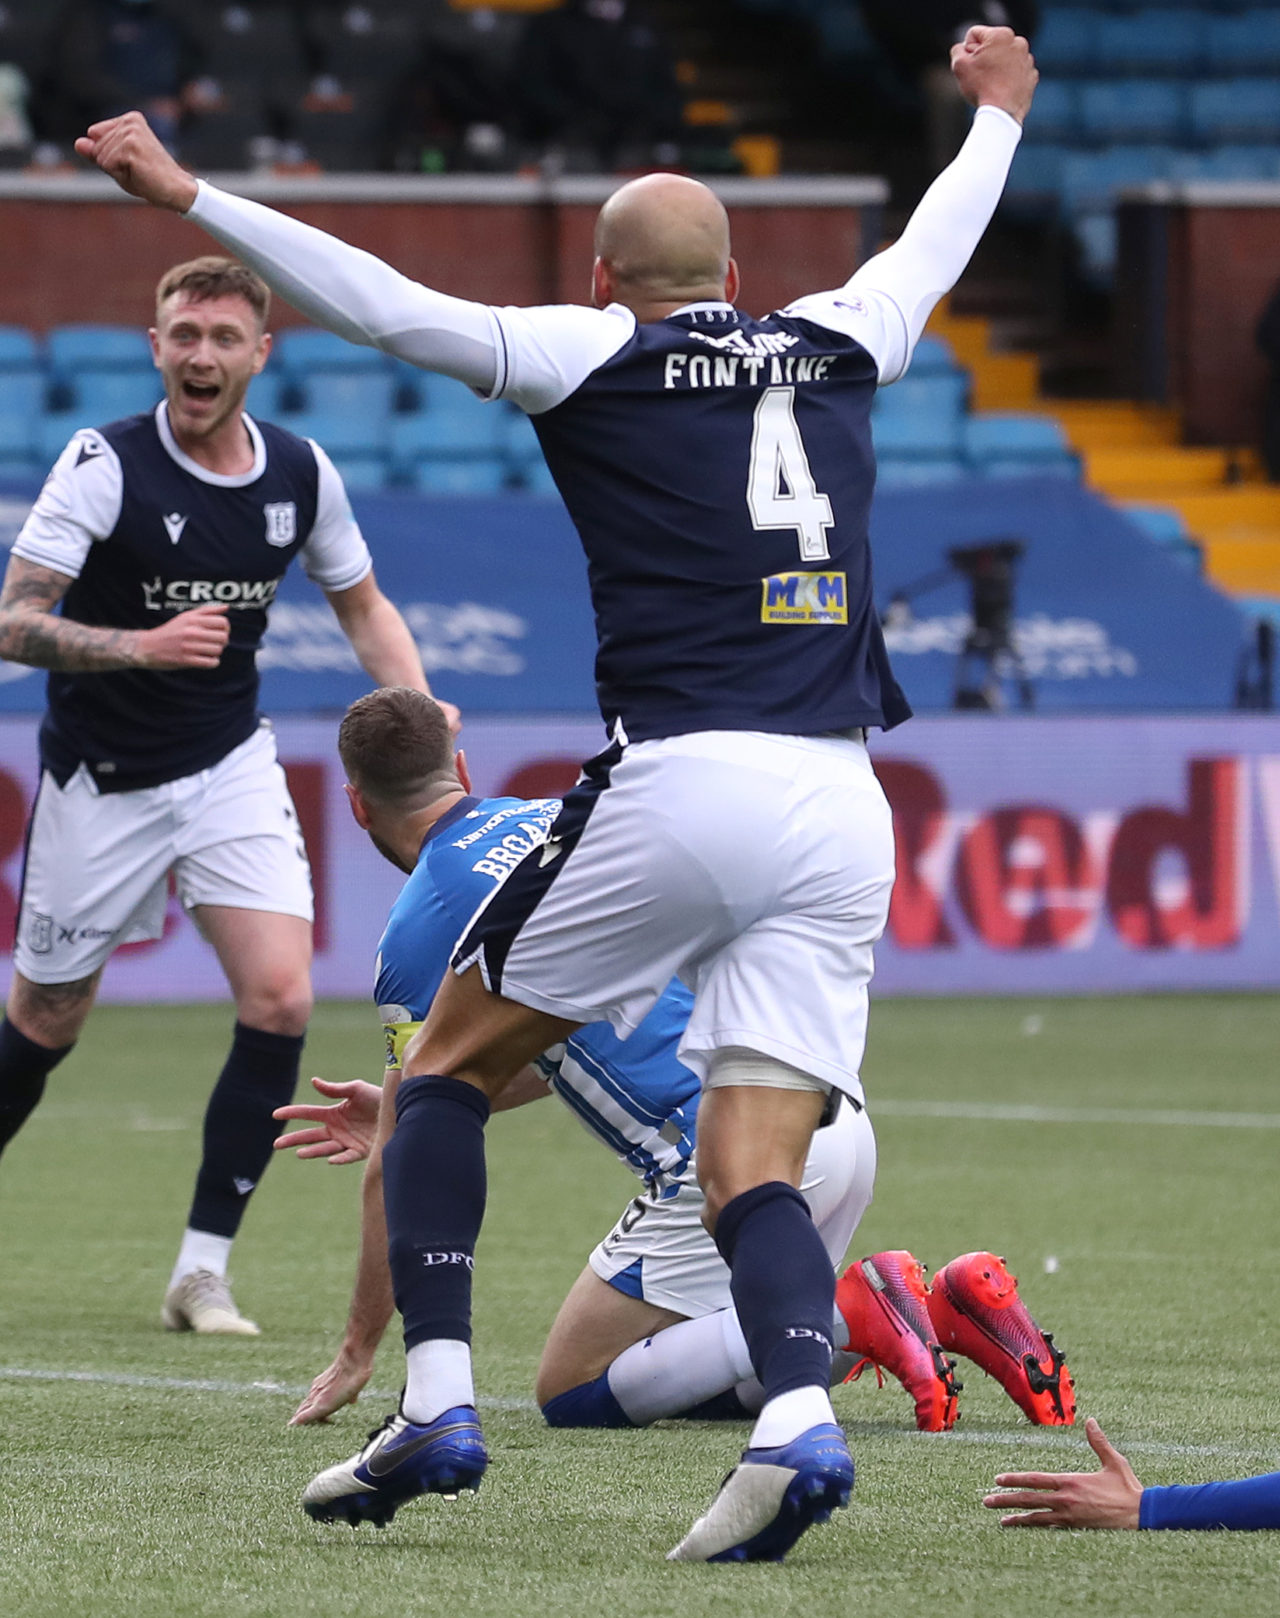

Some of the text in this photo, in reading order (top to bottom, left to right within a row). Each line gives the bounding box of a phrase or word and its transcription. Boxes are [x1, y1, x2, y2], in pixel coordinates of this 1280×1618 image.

[664, 352, 837, 389] FONTAINE
[746, 386, 835, 562] 4
[165, 579, 279, 601] CROW
[766, 576, 845, 607] MKM
